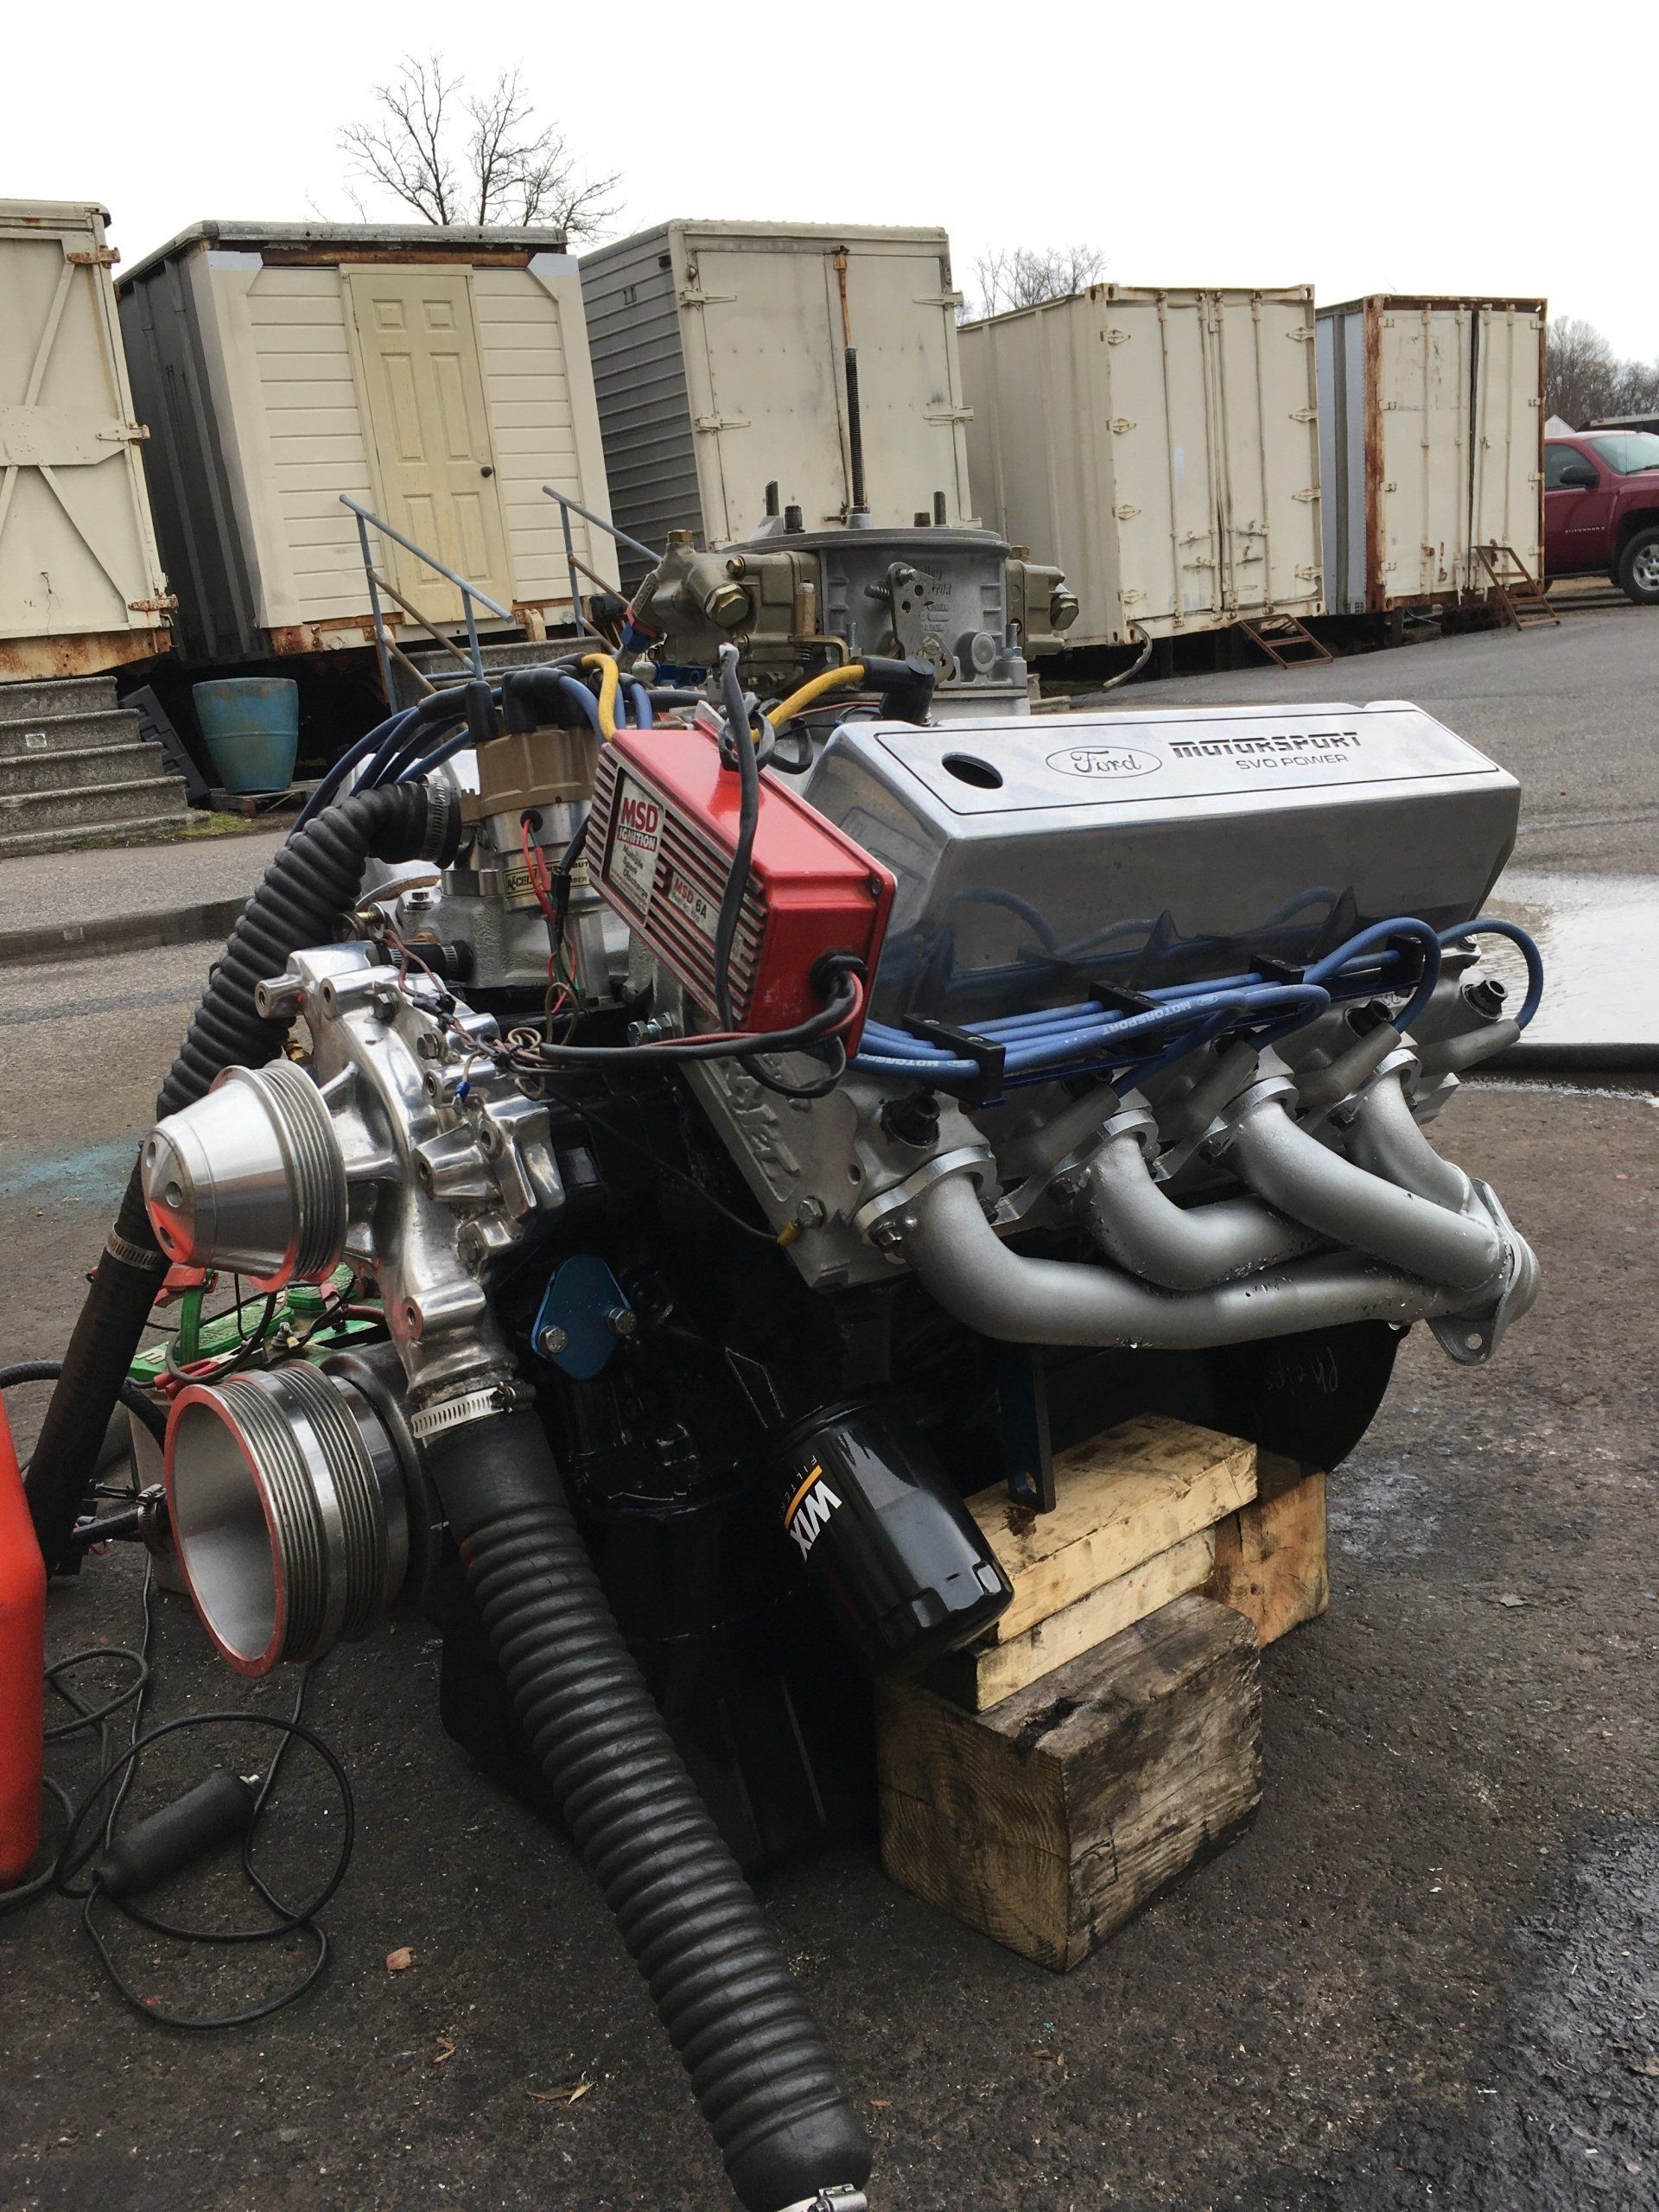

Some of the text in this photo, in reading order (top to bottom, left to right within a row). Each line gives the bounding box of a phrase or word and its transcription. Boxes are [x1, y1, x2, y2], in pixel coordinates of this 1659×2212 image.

[1169, 732, 1362, 759] MOTORSPORT
[1071, 750, 1141, 774] Ford
[1236, 753, 1351, 771] SVO POWER
[621, 797, 658, 834] MSD
[618, 827, 656, 850] IGNITION
[674, 879, 694, 904] MSD
[695, 899, 707, 919] 6A
[1102, 1001, 1192, 1035] MOTORSPORT
[790, 1480, 842, 1561] WIX
